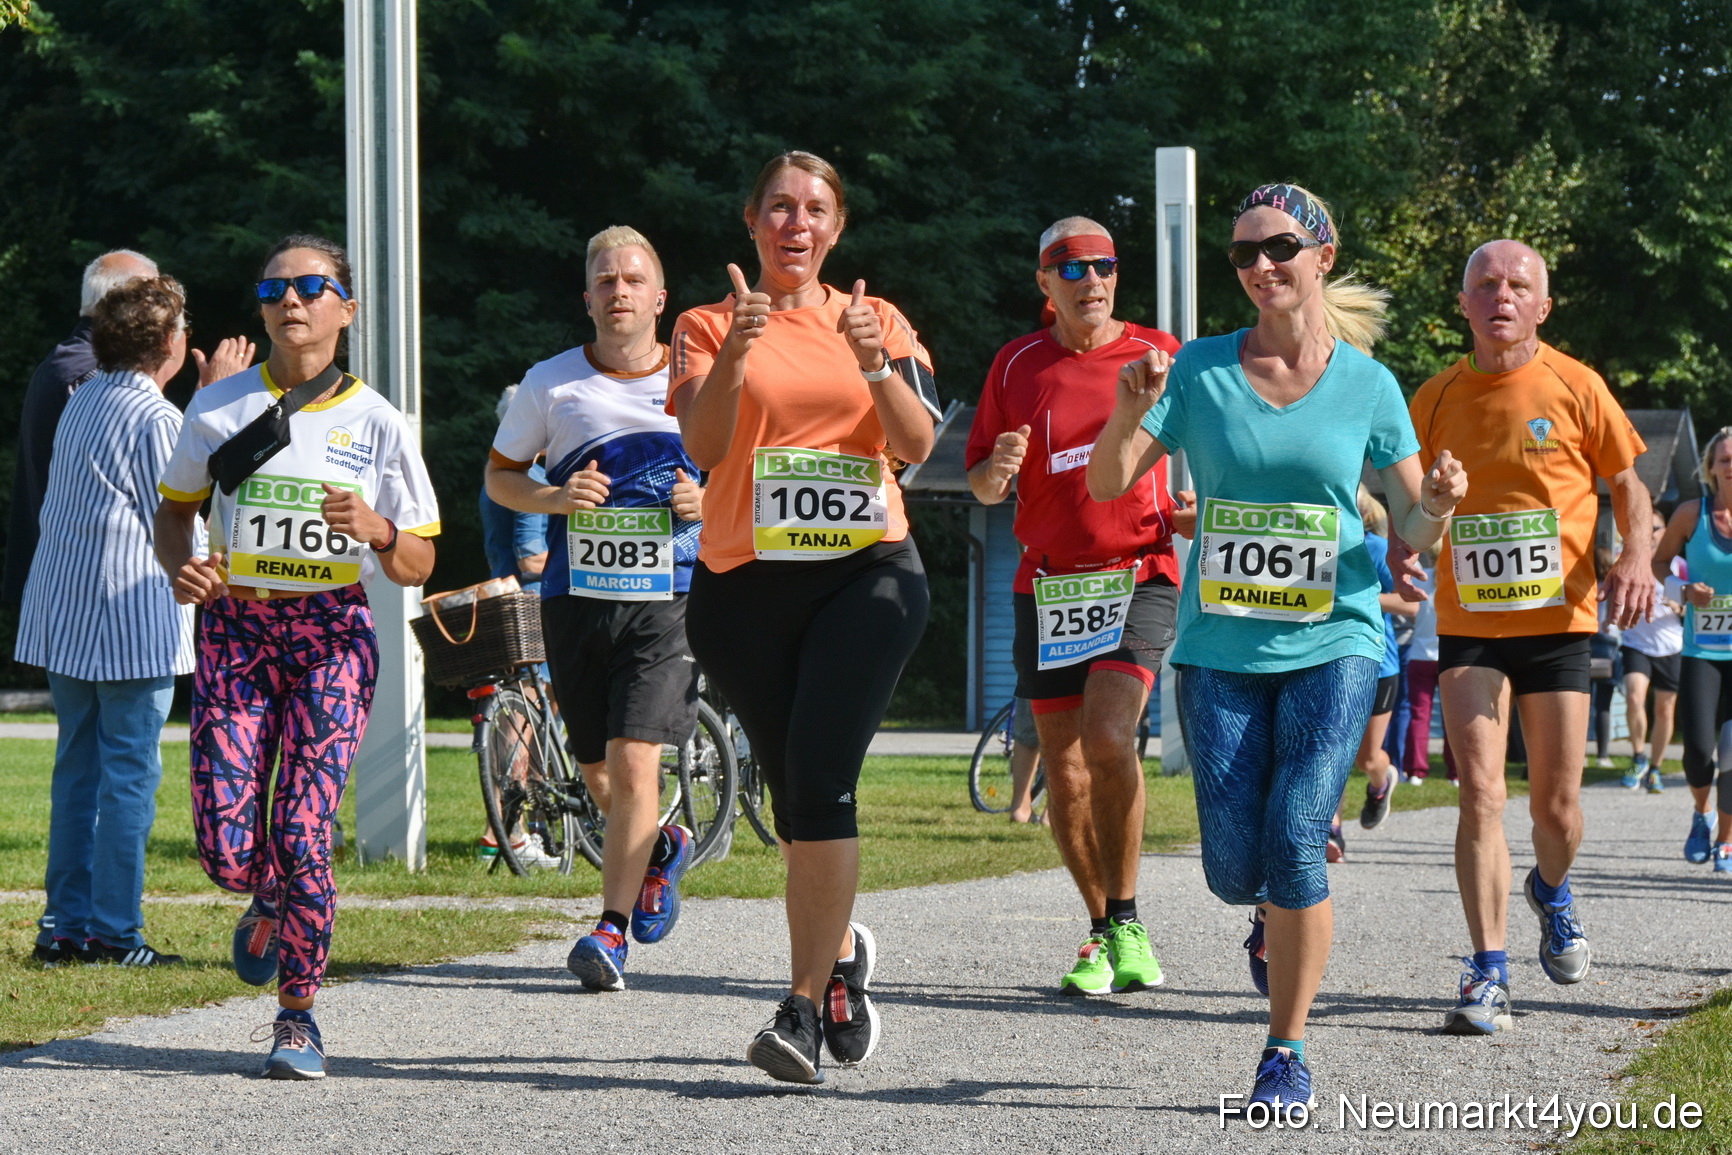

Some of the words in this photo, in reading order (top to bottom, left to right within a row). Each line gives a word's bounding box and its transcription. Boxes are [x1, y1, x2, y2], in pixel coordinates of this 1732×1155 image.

[329, 431, 351, 447] 20
[325, 456, 365, 475] Stadtlauf
[764, 452, 874, 483] BOCK
[246, 478, 360, 509] BOC
[770, 487, 871, 522] 1062
[575, 509, 664, 532] BOCK
[1212, 504, 1327, 536] BOCK
[1457, 513, 1550, 542] BOCK
[249, 514, 349, 556] 1166
[787, 532, 852, 547] TANJA
[579, 539, 659, 568] 2083
[1218, 541, 1317, 581] 1061
[1465, 544, 1549, 579] 1015
[255, 559, 333, 580] RENATA
[586, 575, 652, 590] MARCUS
[1043, 574, 1127, 601] BOCK
[1219, 587, 1308, 608] DANIELA
[1477, 585, 1542, 600] ROLAND
[1049, 602, 1122, 637] 2585
[1048, 632, 1115, 657] ALEXANDER
